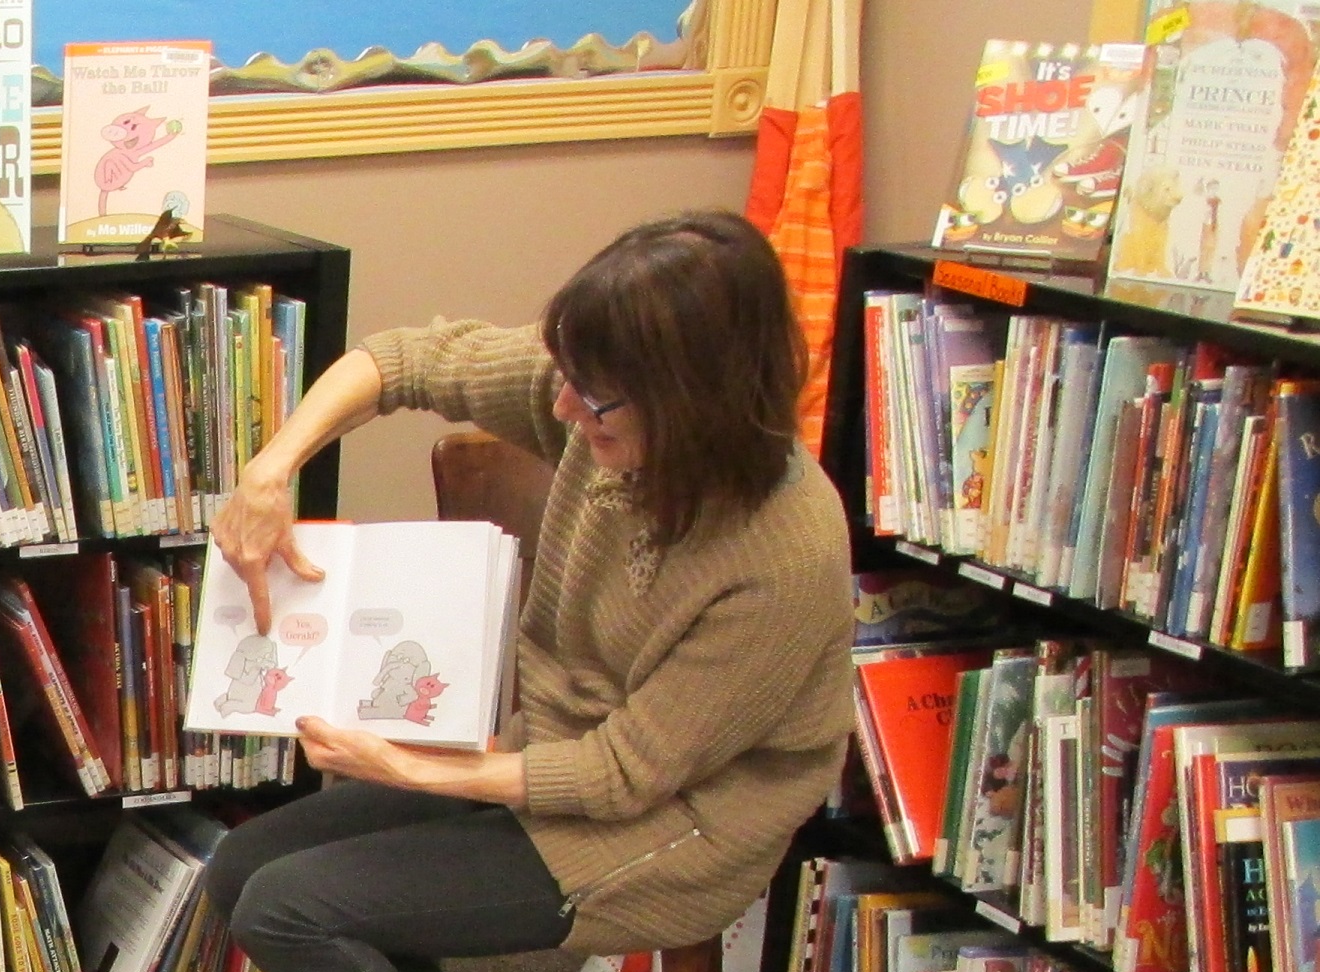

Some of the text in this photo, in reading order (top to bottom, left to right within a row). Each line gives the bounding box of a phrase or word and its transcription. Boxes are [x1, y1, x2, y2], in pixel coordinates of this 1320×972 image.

[71, 64, 201, 80] Watch Me Throw
[1036, 61, 1071, 81] It's
[101, 79, 169, 95] the Ball!
[1189, 85, 1276, 106] PRINCE
[976, 75, 1096, 118] SHOE
[985, 111, 1081, 140] TIME!
[97, 224, 118, 236] Mo
[994, 232, 1024, 243] Bryan
[285, 630, 320, 641] Gerald?
[11, 914, 21, 934] ROSIE
[14, 936, 24, 954] GOES
[44, 929, 55, 948] MATH
[16, 956, 25, 966] TO
